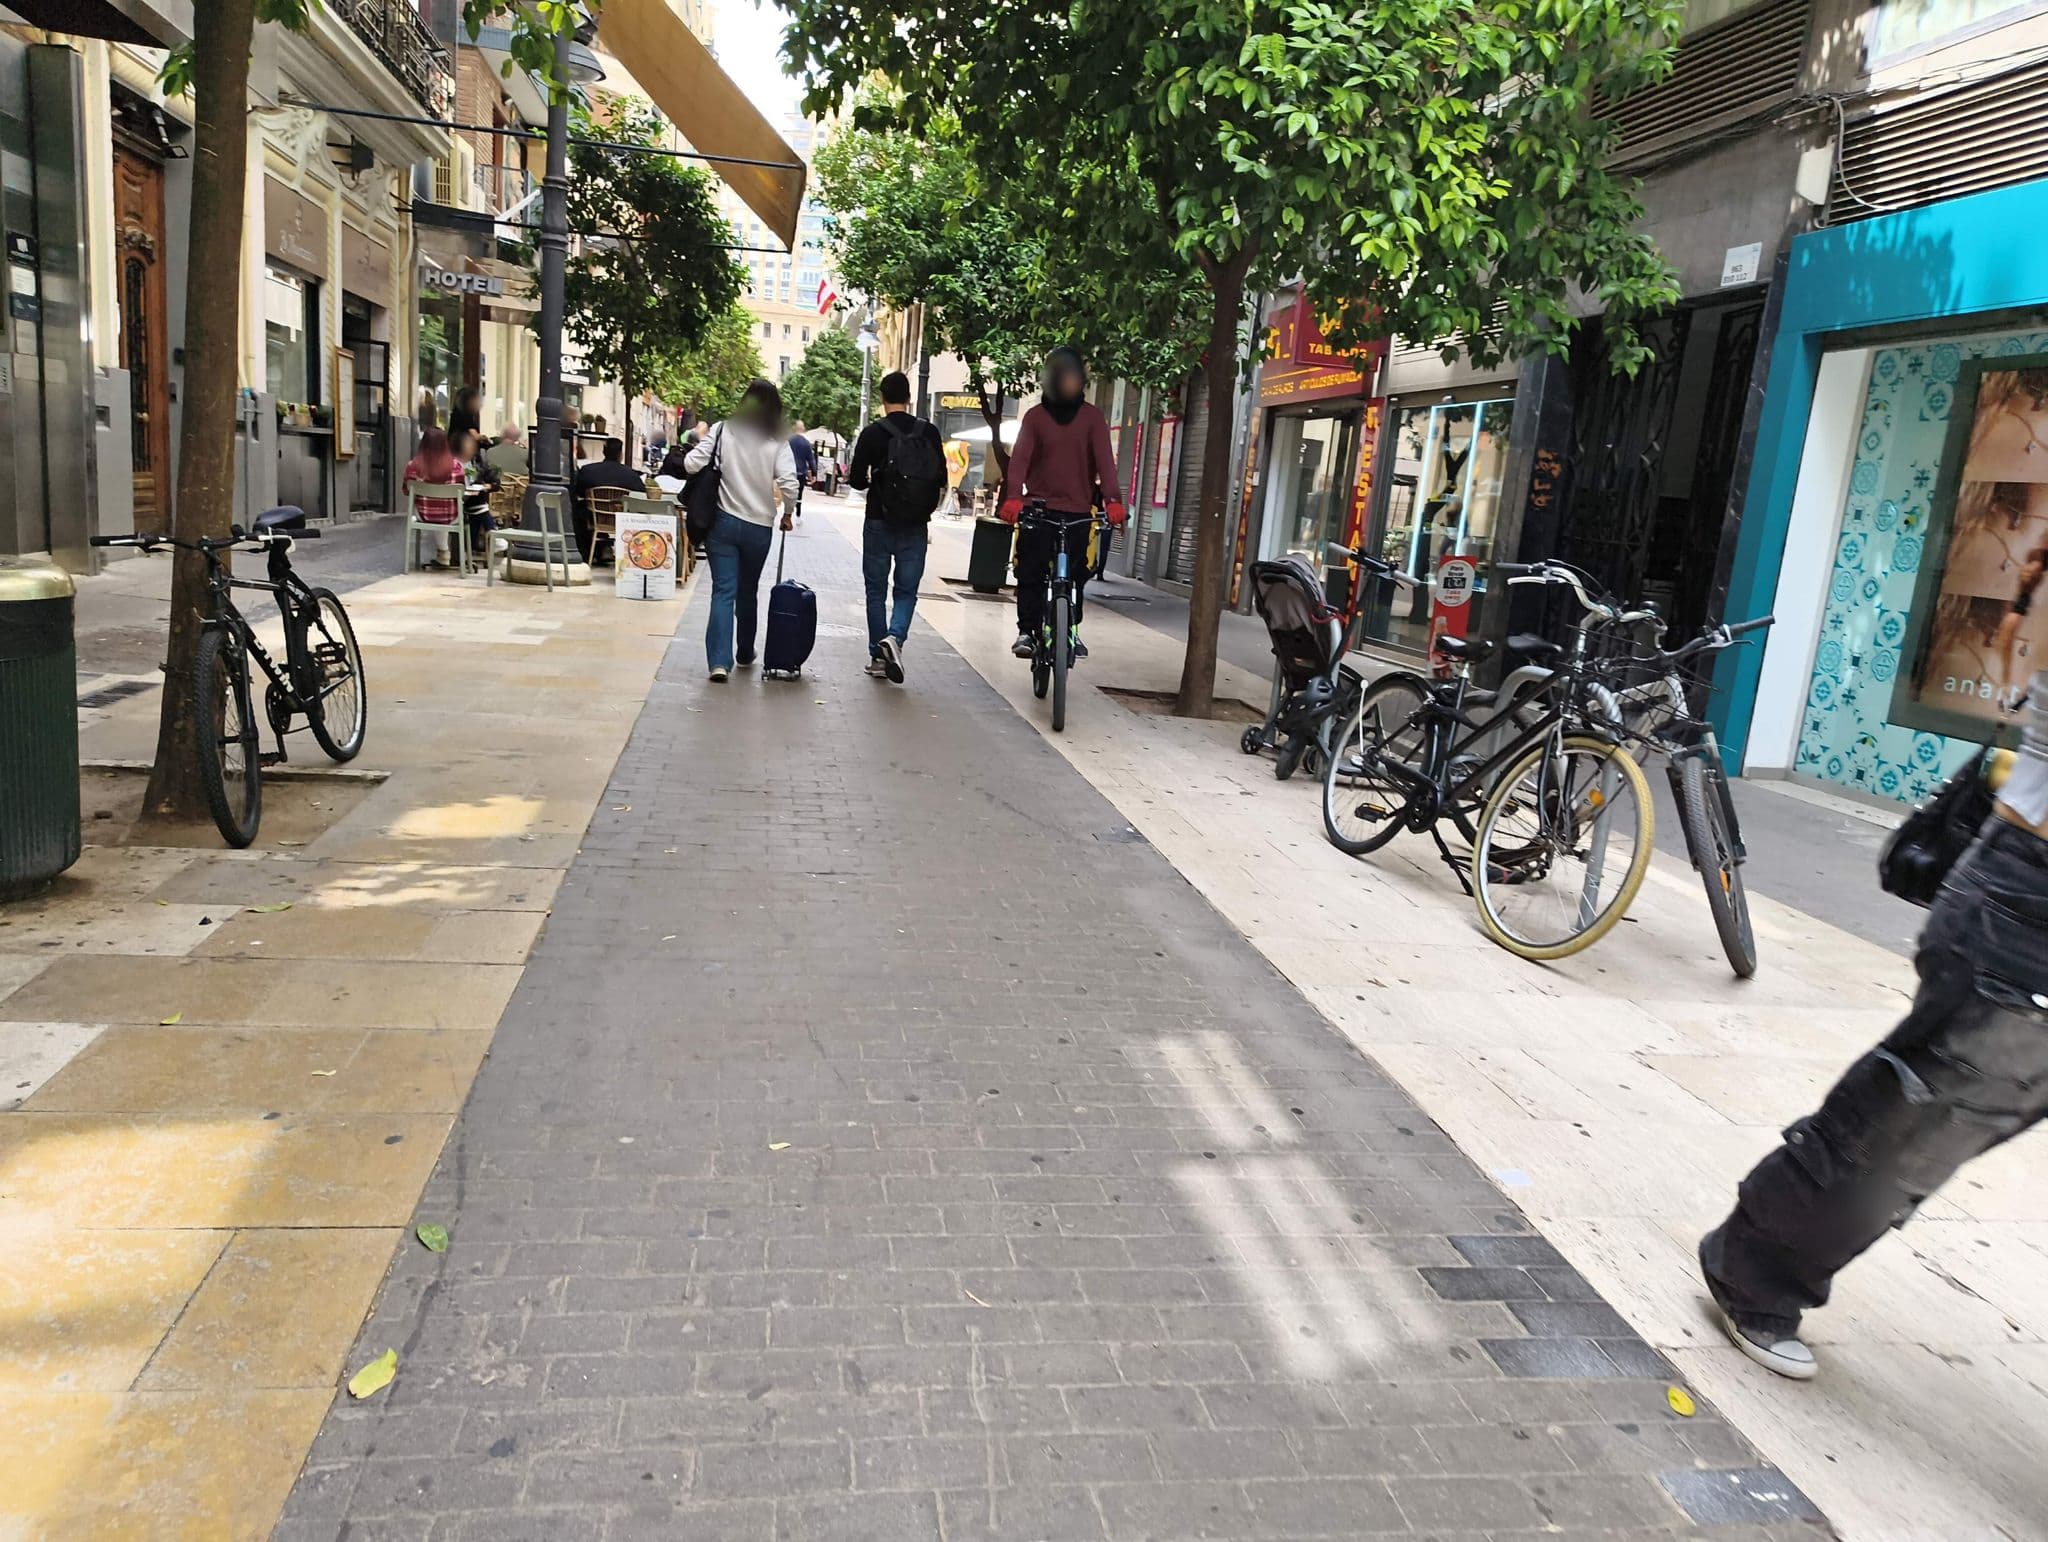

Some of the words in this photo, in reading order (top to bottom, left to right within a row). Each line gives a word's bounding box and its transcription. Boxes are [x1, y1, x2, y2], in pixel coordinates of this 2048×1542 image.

[425, 268, 502, 297] HOTEL
[1308, 342, 1368, 359] TABCOS
[1943, 675, 2021, 704] anart
